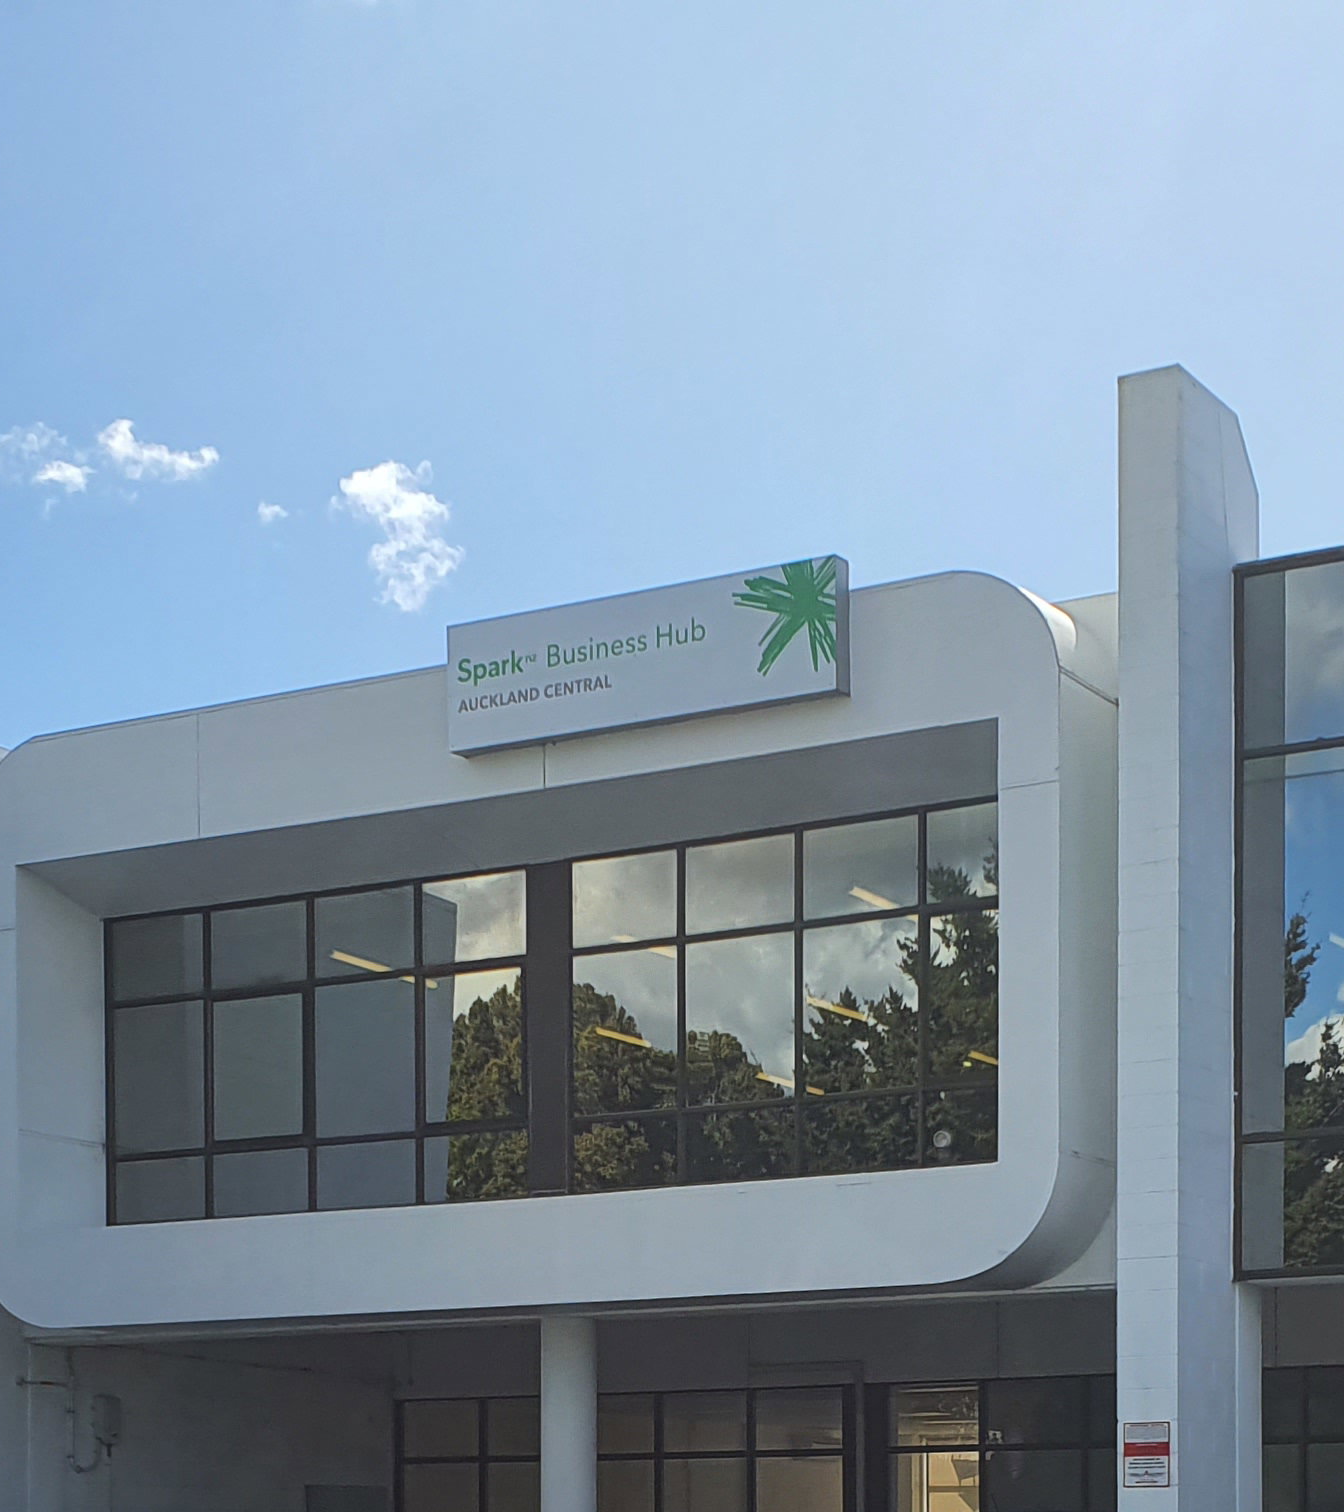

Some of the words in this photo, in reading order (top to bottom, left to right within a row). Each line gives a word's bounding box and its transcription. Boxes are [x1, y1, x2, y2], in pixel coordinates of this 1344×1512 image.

[457, 650, 525, 686] Spark
[547, 633, 648, 669] Business
[655, 617, 707, 649] Hub
[458, 686, 540, 714] AUCKLAND
[544, 674, 613, 700] CENTRAL
